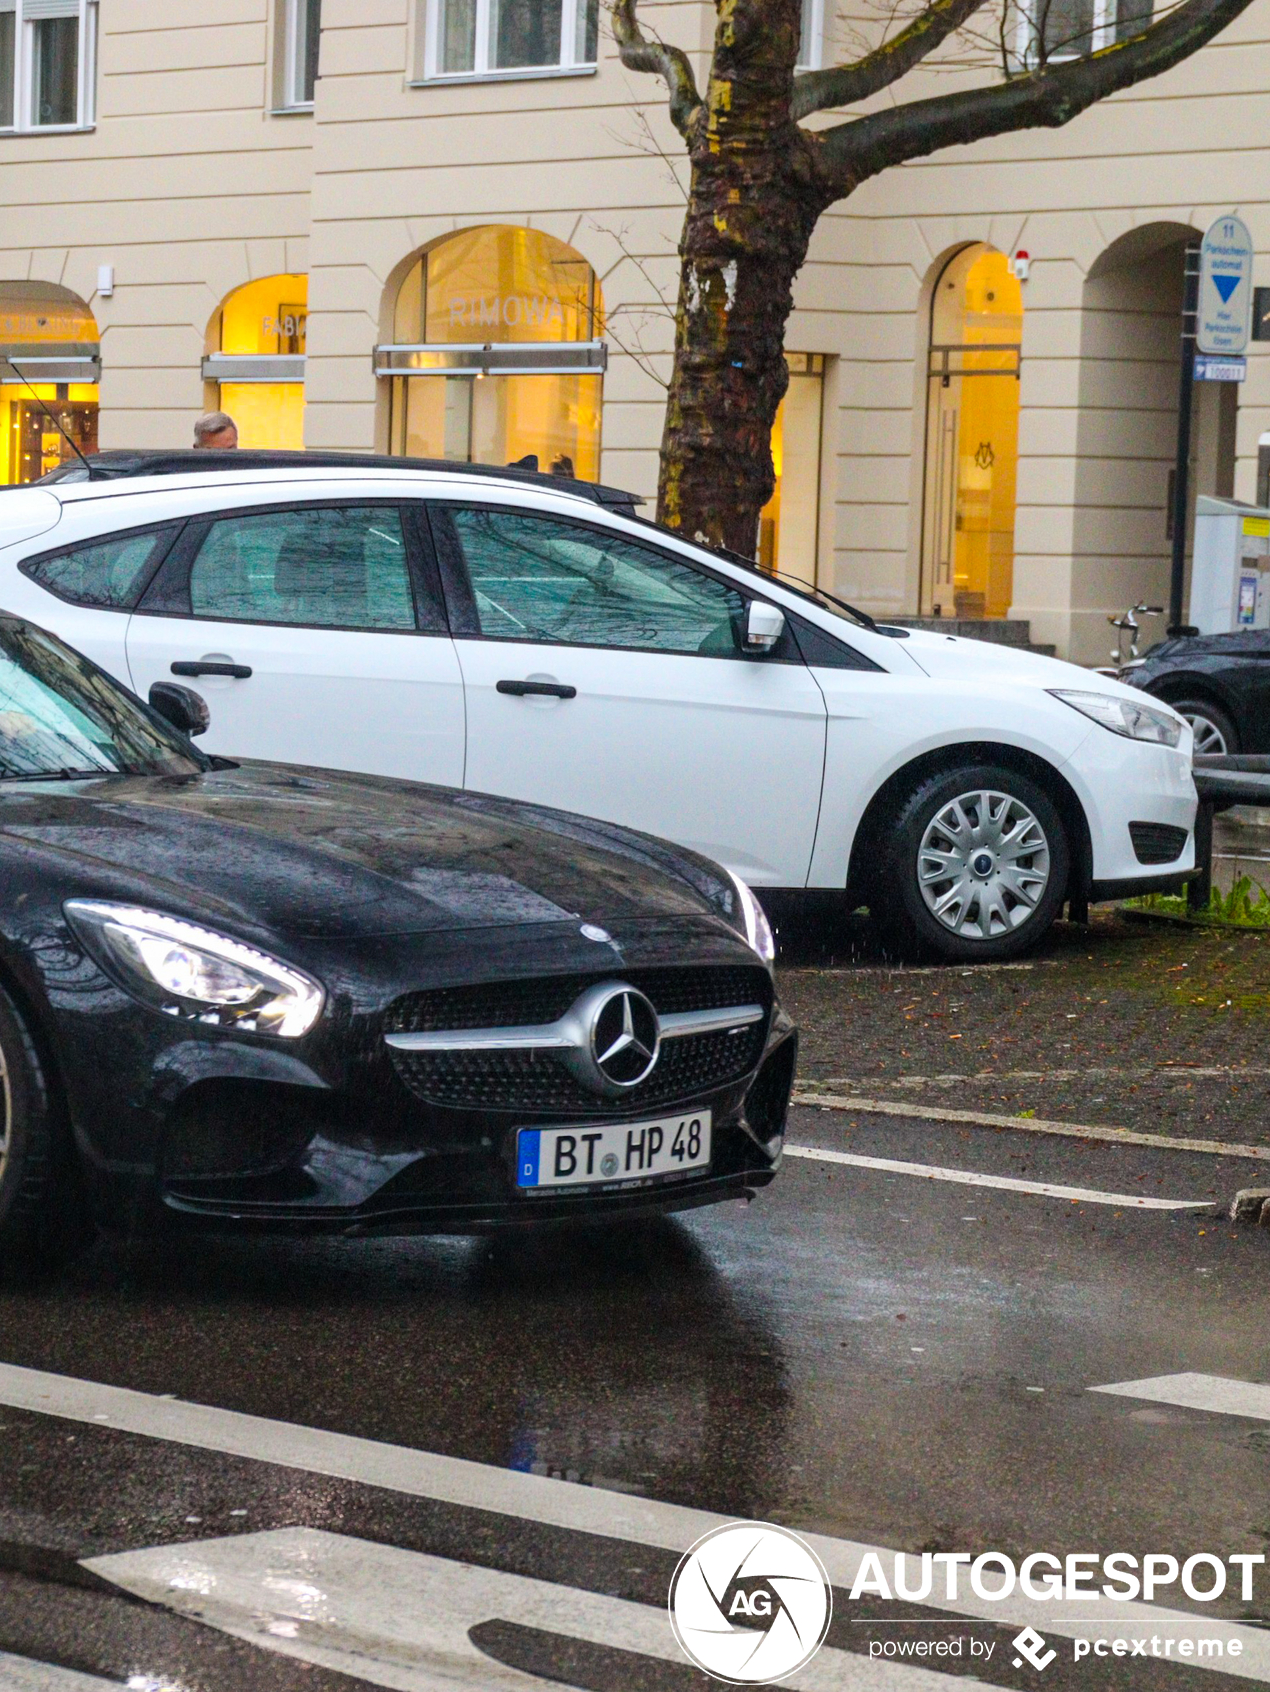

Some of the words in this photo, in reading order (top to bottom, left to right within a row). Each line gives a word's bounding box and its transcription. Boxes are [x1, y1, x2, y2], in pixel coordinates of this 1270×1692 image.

[1223, 224, 1234, 238] 11
[1212, 260, 1243, 271] automat
[449, 296, 564, 327] RIMOWA
[523, 1163, 533, 1176] D
[554, 1133, 602, 1177] BT
[625, 1126, 663, 1171] HP
[670, 1118, 701, 1162] 48
